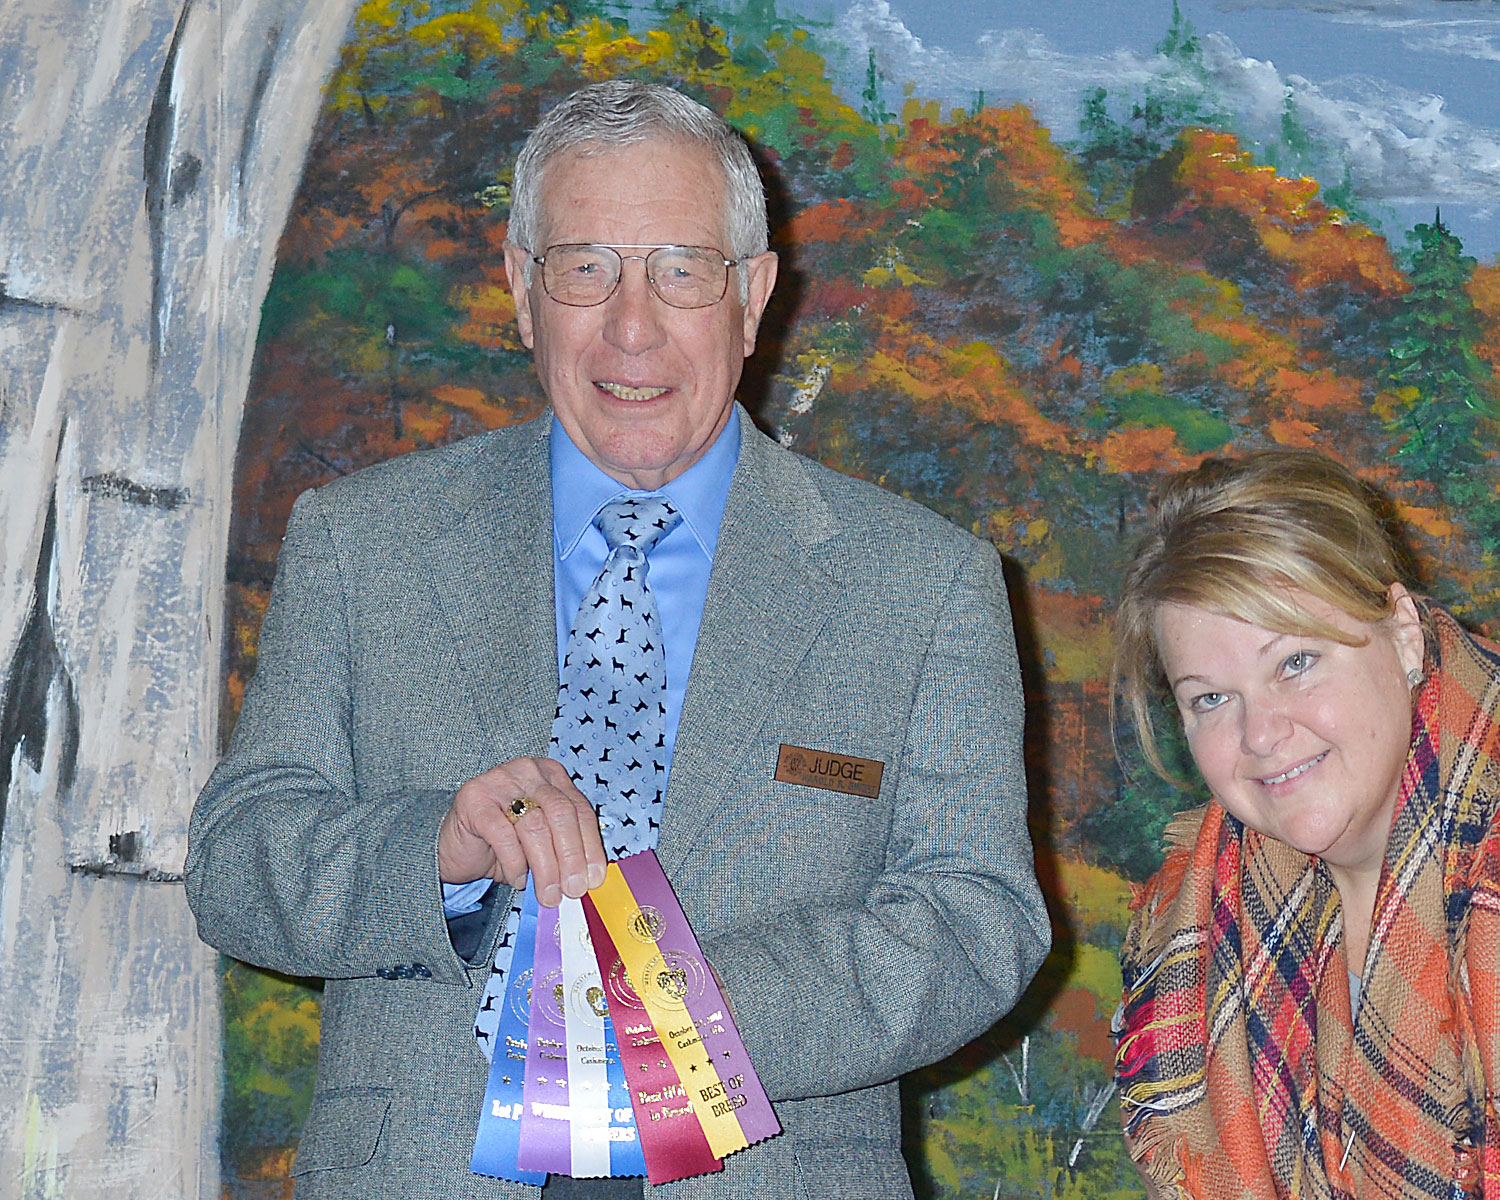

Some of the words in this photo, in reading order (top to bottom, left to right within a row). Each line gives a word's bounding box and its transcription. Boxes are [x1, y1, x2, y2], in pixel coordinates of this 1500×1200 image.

[809, 757, 864, 781] JUDGE
[699, 1081, 727, 1102] BEST
[728, 1073, 745, 1090] OF
[710, 1093, 748, 1118] BREED
